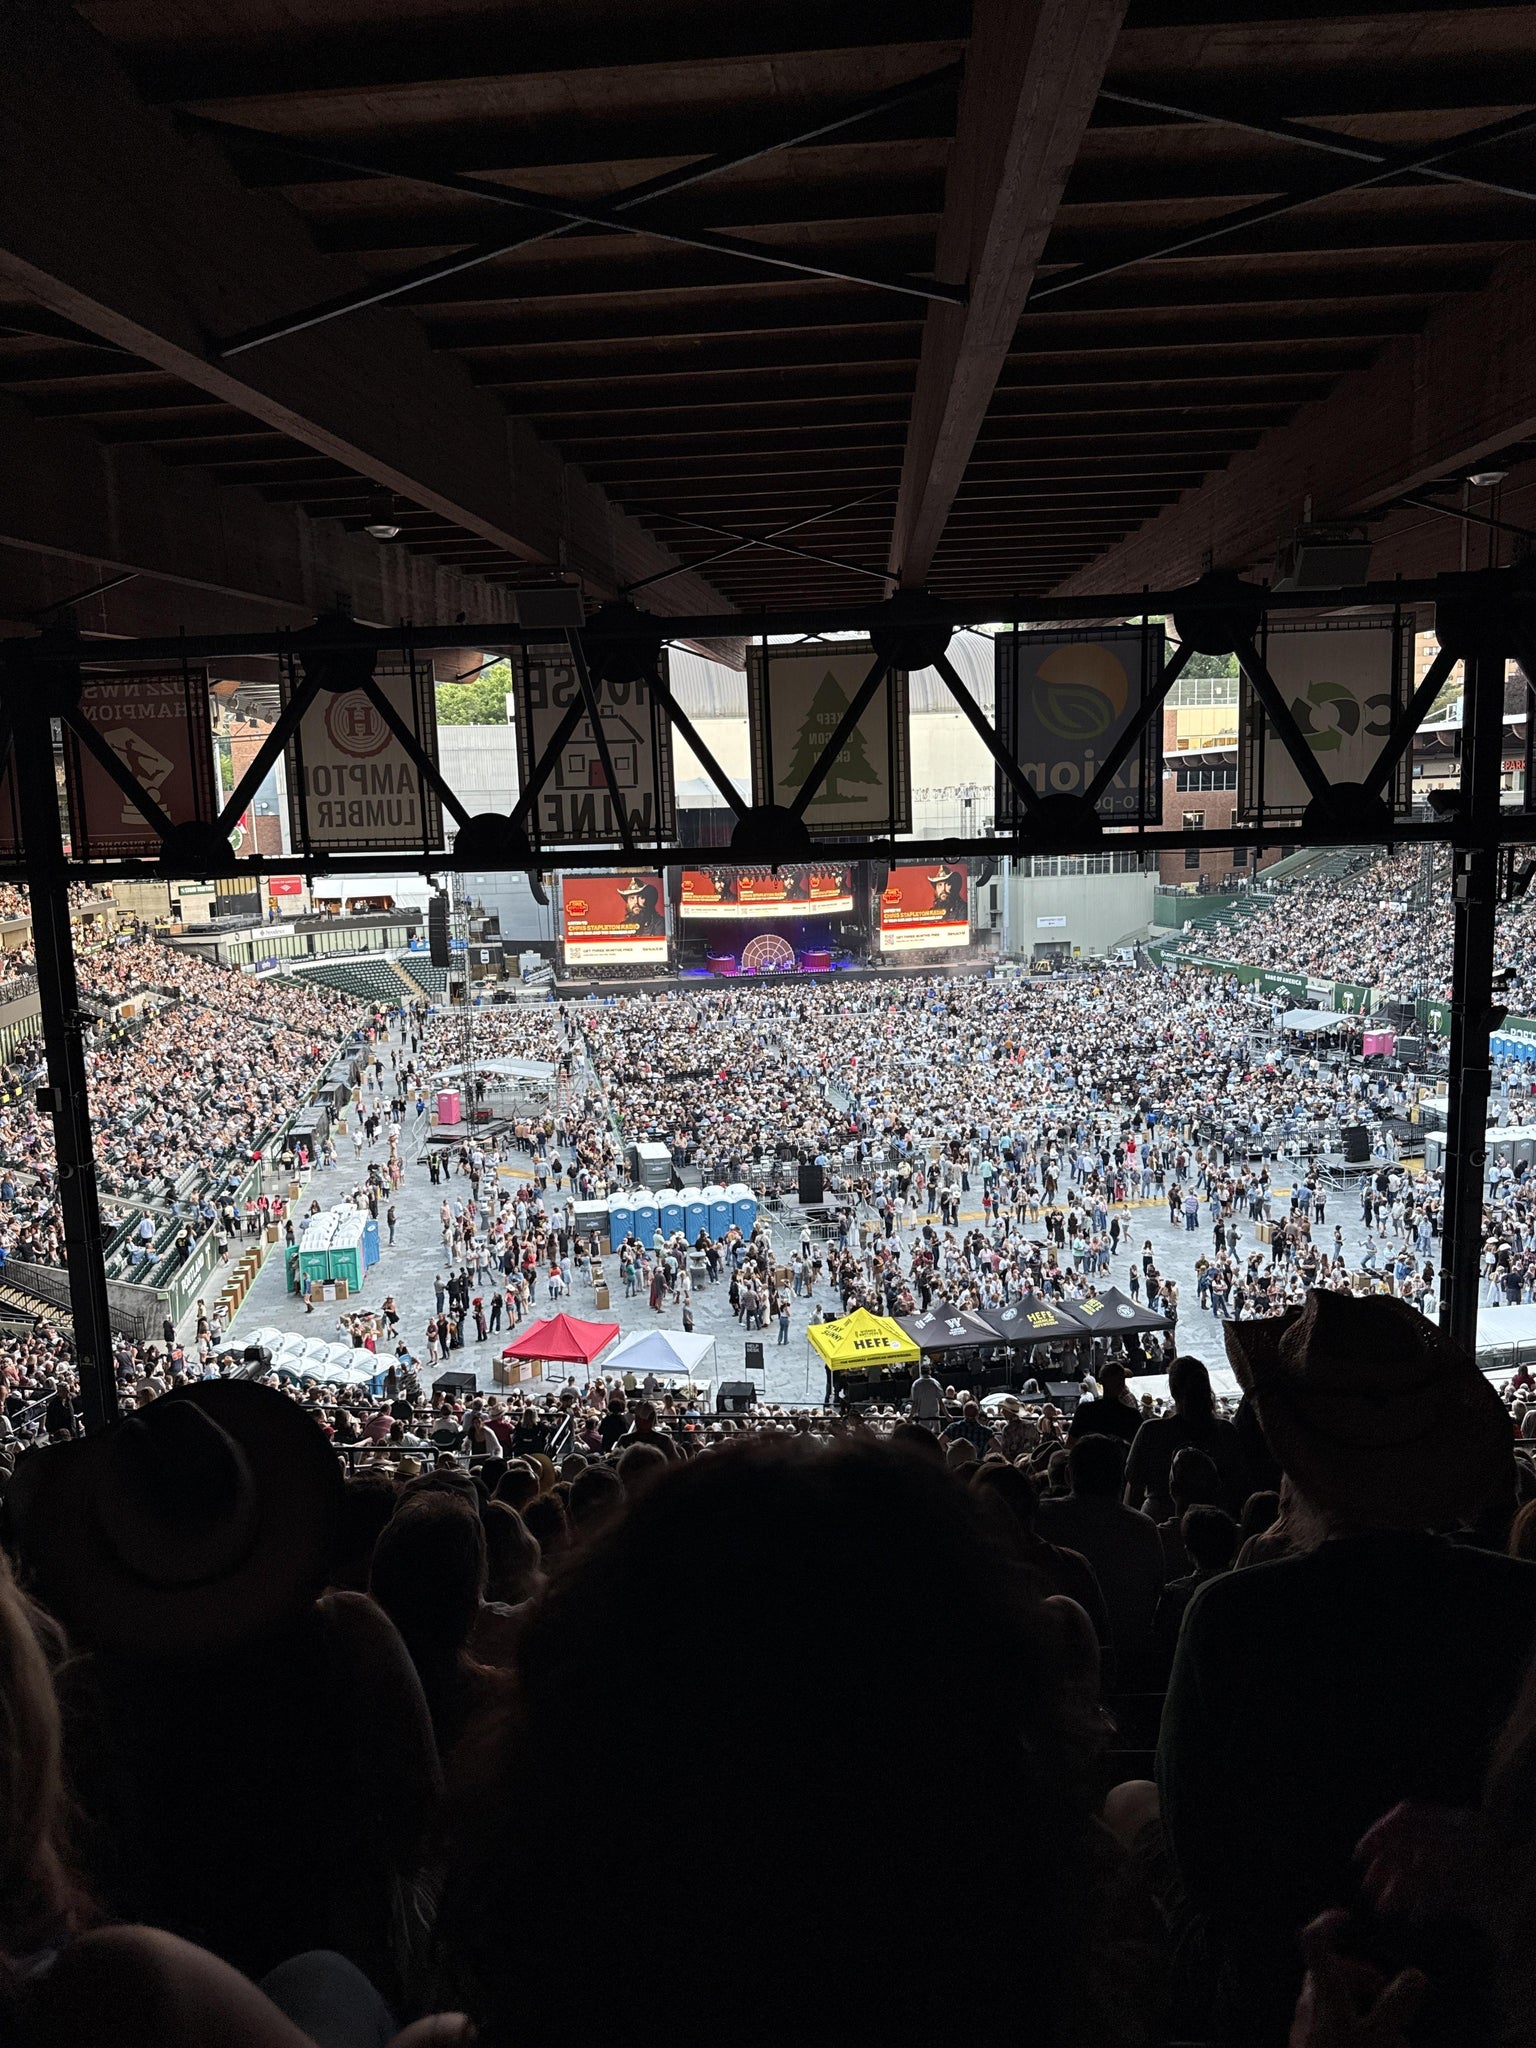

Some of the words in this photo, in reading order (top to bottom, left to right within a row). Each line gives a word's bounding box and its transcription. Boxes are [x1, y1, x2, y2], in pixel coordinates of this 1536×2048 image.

[1282, 977, 1302, 986] AMERICA
[1026, 1310, 1054, 1322] HEFE
[825, 1324, 844, 1333] STAY
[821, 1329, 843, 1342] SUNNY
[853, 1337, 890, 1350] HEFE
